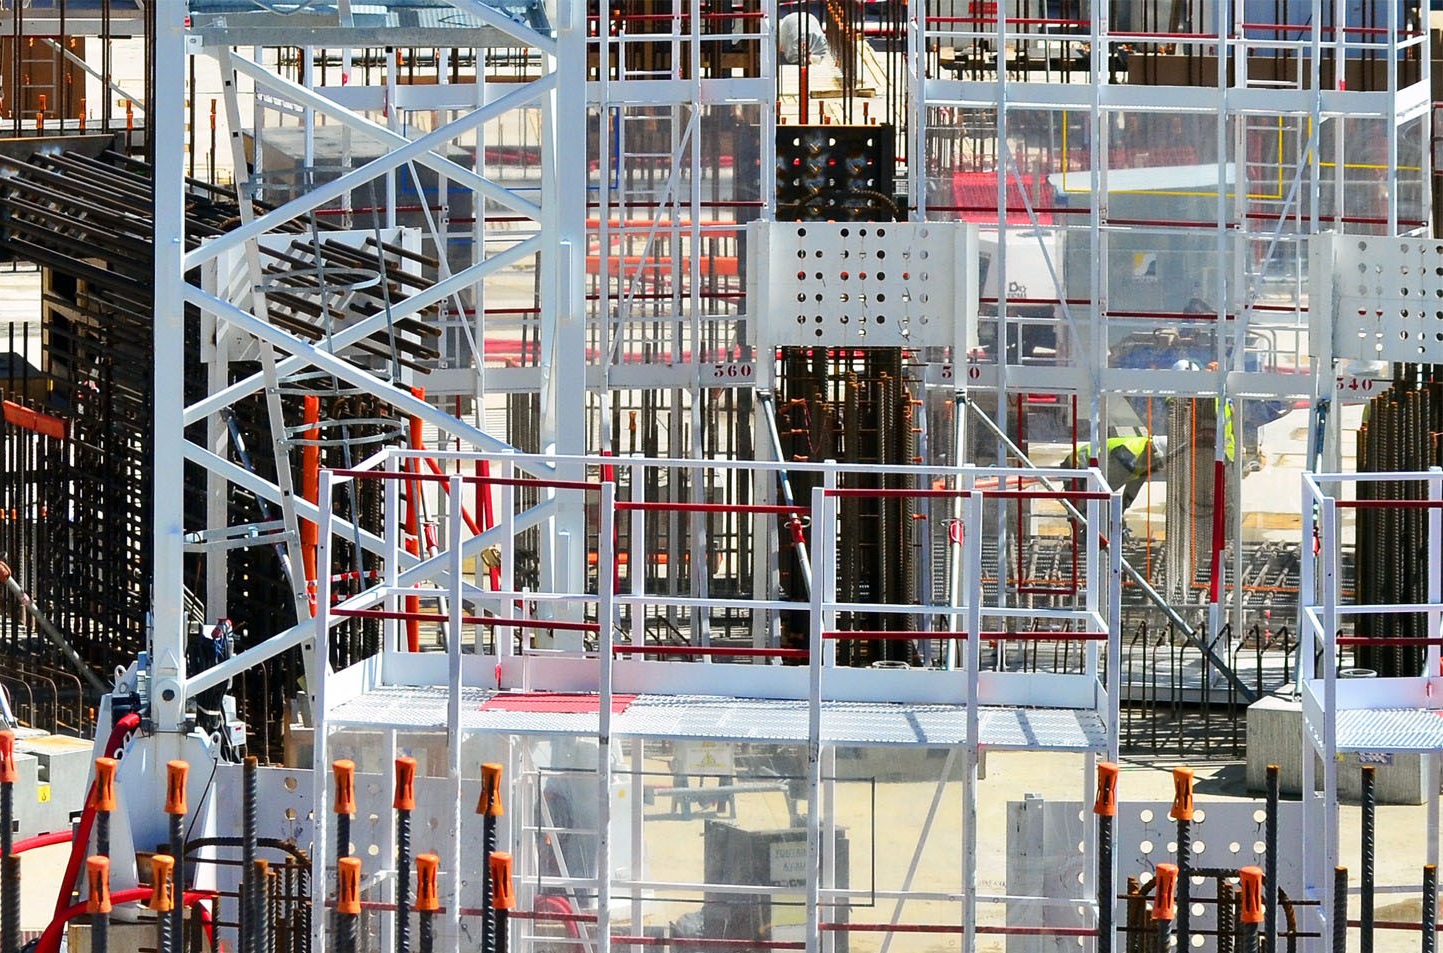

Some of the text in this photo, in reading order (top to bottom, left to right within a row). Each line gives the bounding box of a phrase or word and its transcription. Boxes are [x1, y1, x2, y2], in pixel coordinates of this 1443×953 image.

[714, 364, 752, 378] 560
[942, 365, 980, 380] 50
[1336, 377, 1372, 391] 540
